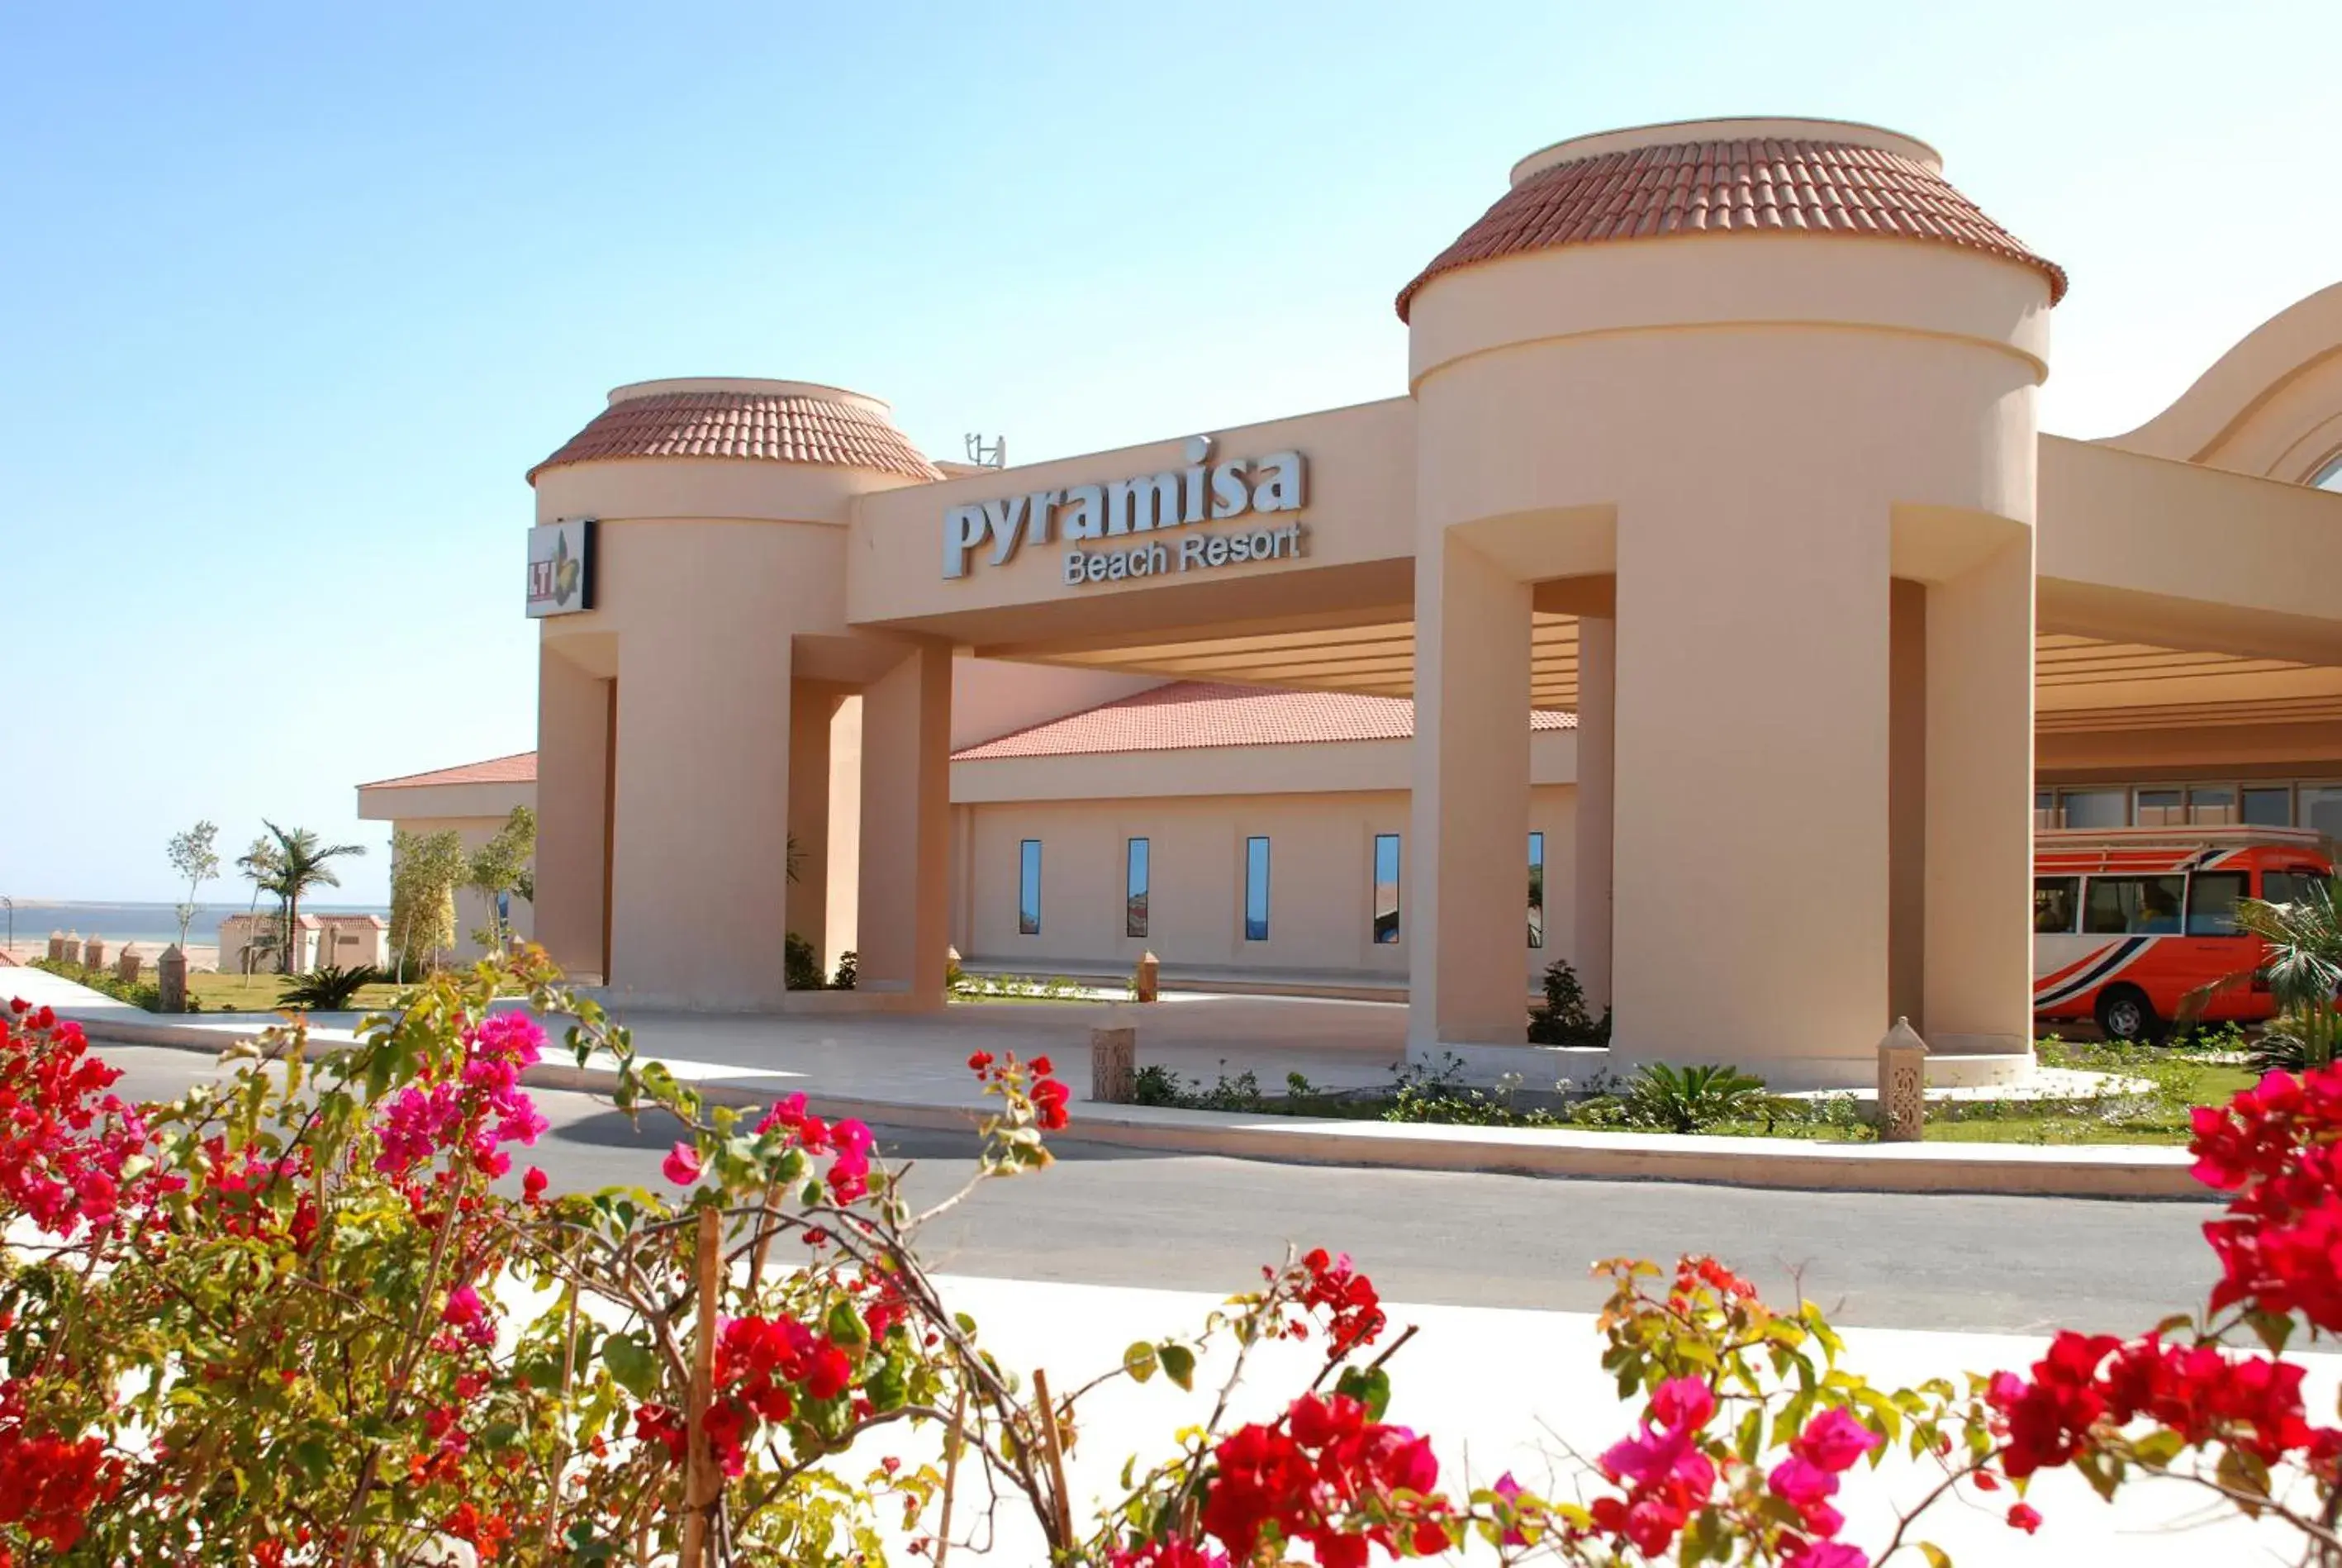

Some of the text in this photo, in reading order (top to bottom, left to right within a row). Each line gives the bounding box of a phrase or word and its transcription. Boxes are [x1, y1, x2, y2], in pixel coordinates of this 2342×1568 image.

[941, 435, 1303, 579] pyramisa
[1062, 522, 1301, 586] Beach Resort
